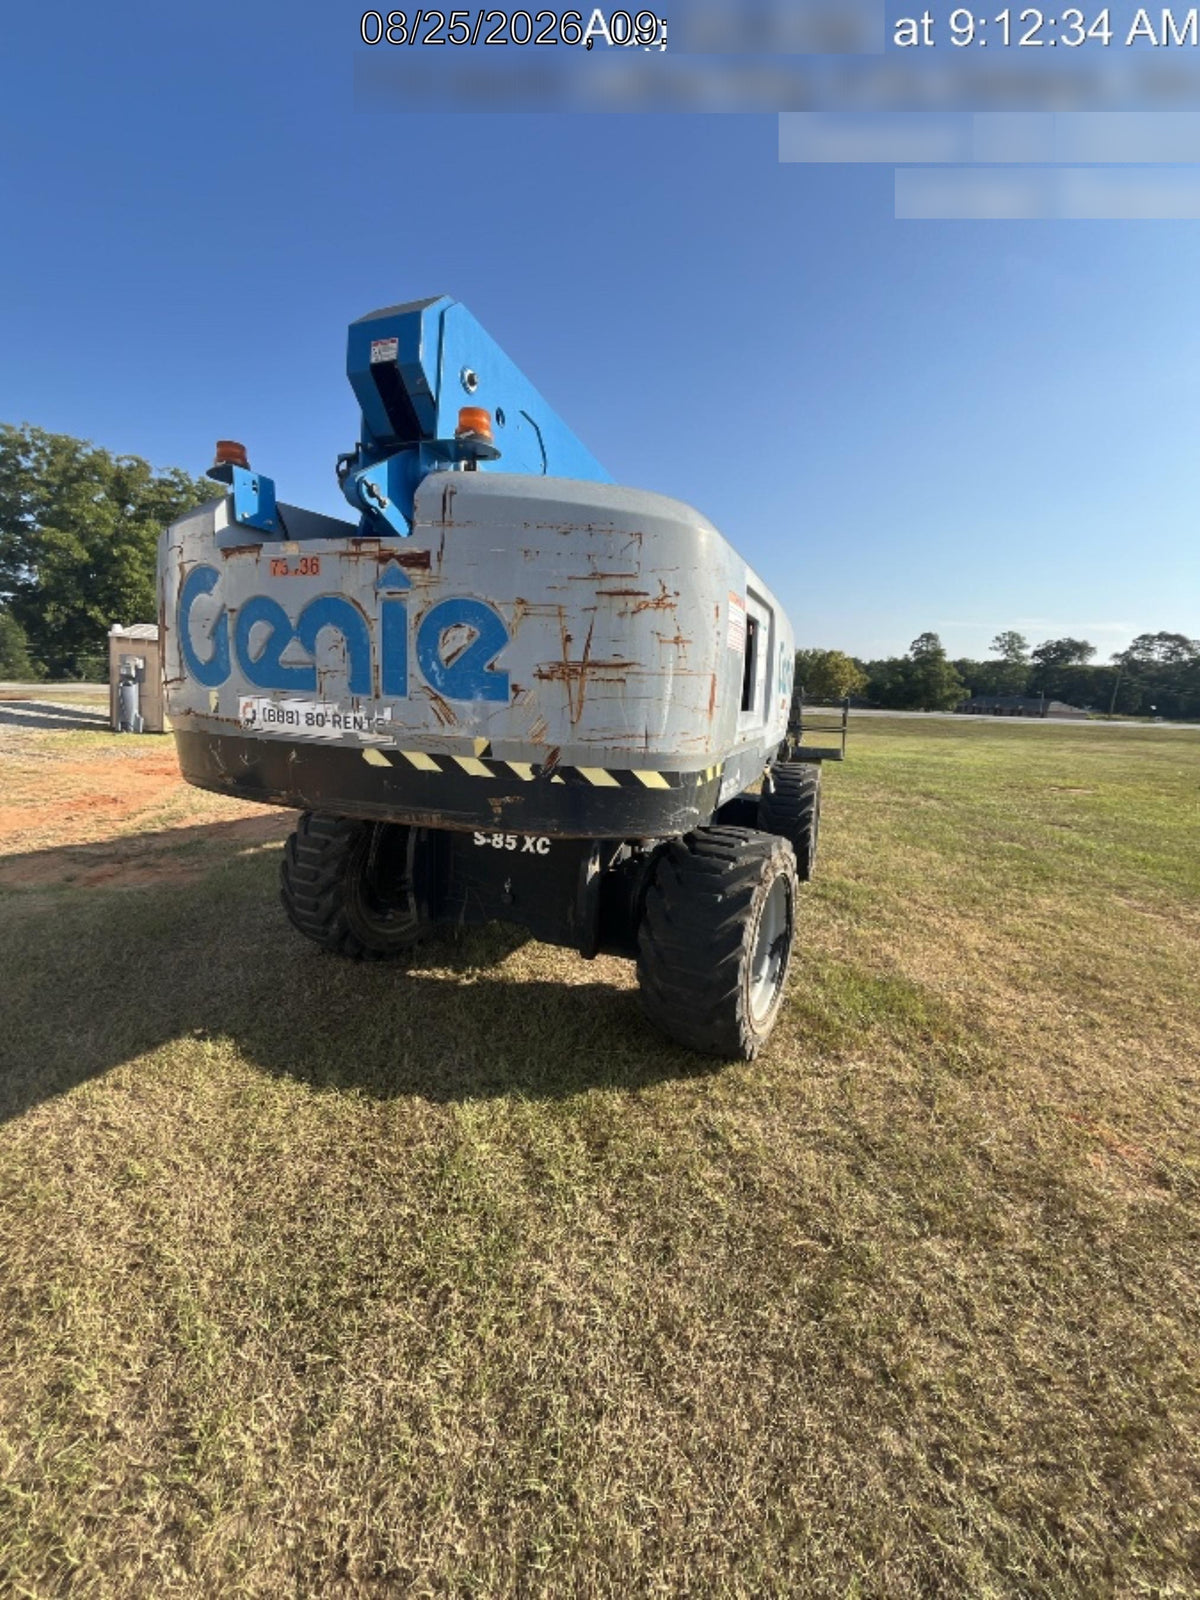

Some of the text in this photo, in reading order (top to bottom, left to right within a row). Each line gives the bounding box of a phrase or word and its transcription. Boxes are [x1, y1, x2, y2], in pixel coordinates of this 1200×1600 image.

[178, 560, 511, 702] Genie
[473, 831, 552, 855] S-85 XC
